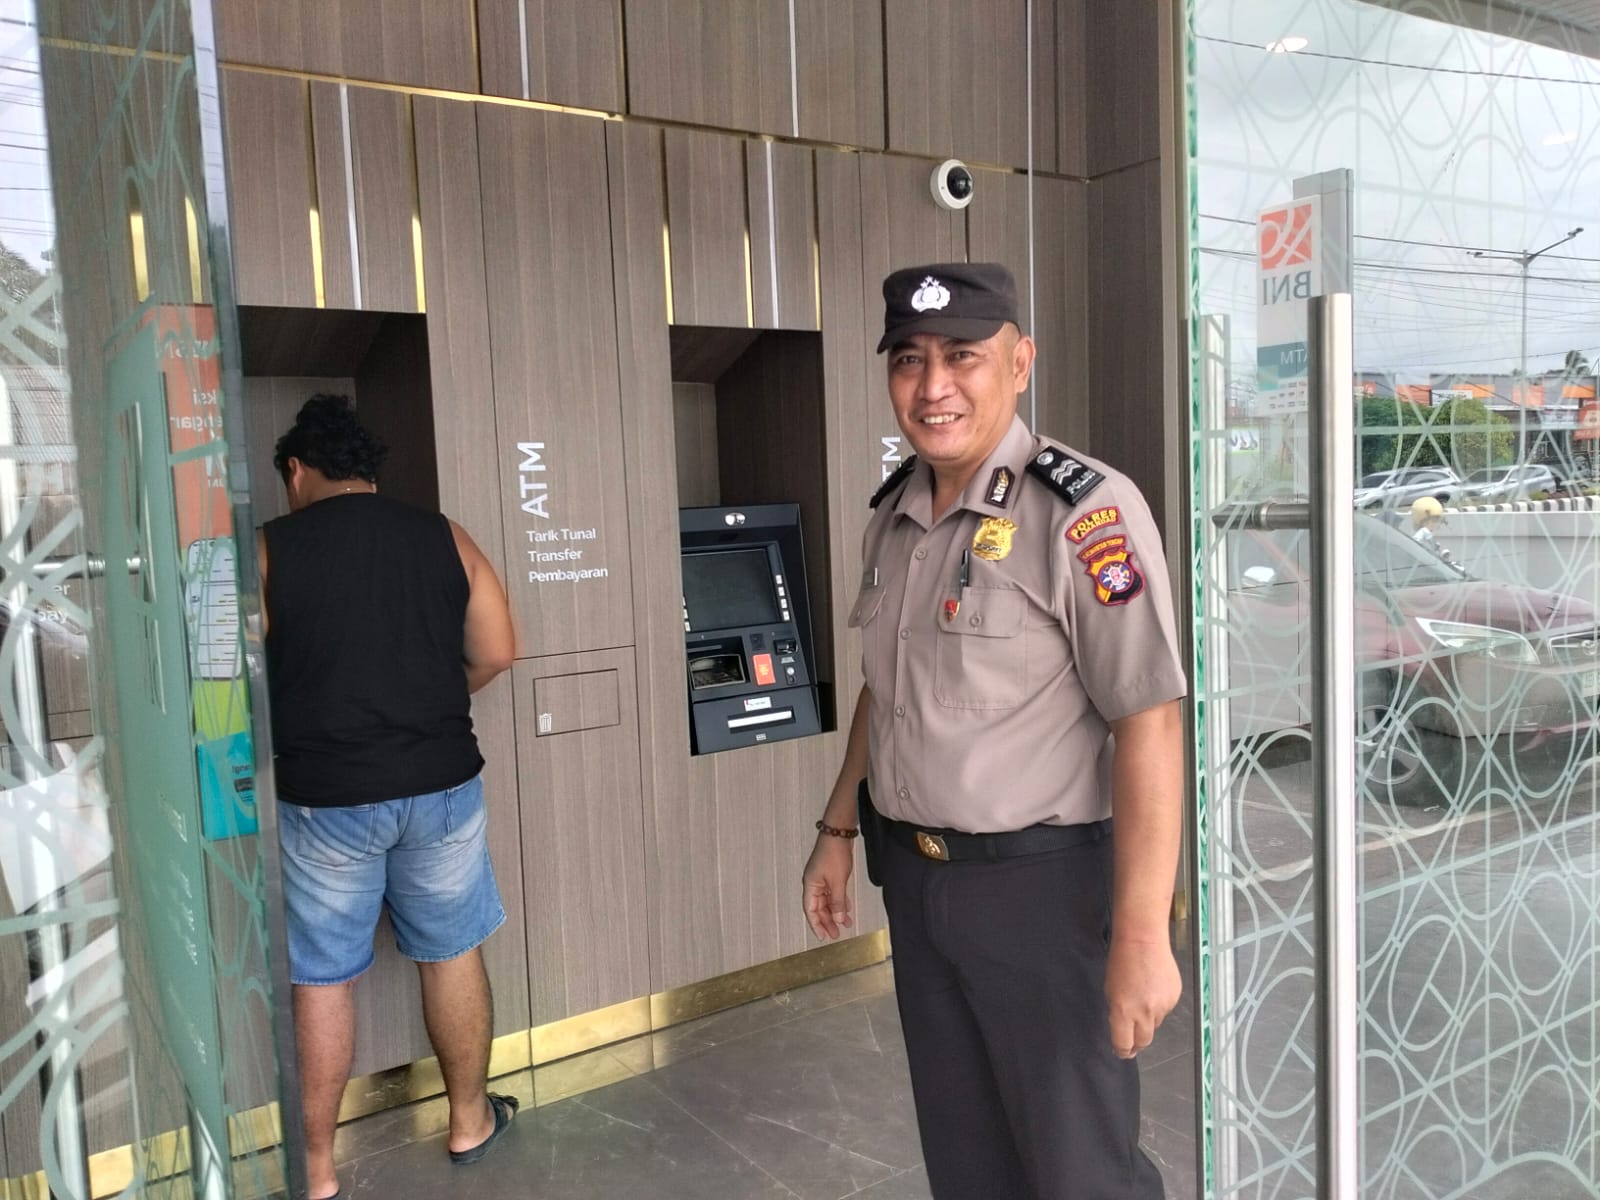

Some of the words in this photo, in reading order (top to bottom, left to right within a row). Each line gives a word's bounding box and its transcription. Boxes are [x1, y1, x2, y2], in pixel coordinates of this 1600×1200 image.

[881, 436, 902, 482] TM
[517, 442, 550, 519] ATM
[526, 530, 559, 543] Tarik
[560, 528, 597, 541] Tunai
[1071, 509, 1117, 539] POLRES
[528, 548, 583, 563] Transfer
[528, 567, 609, 583] Pembayaran
